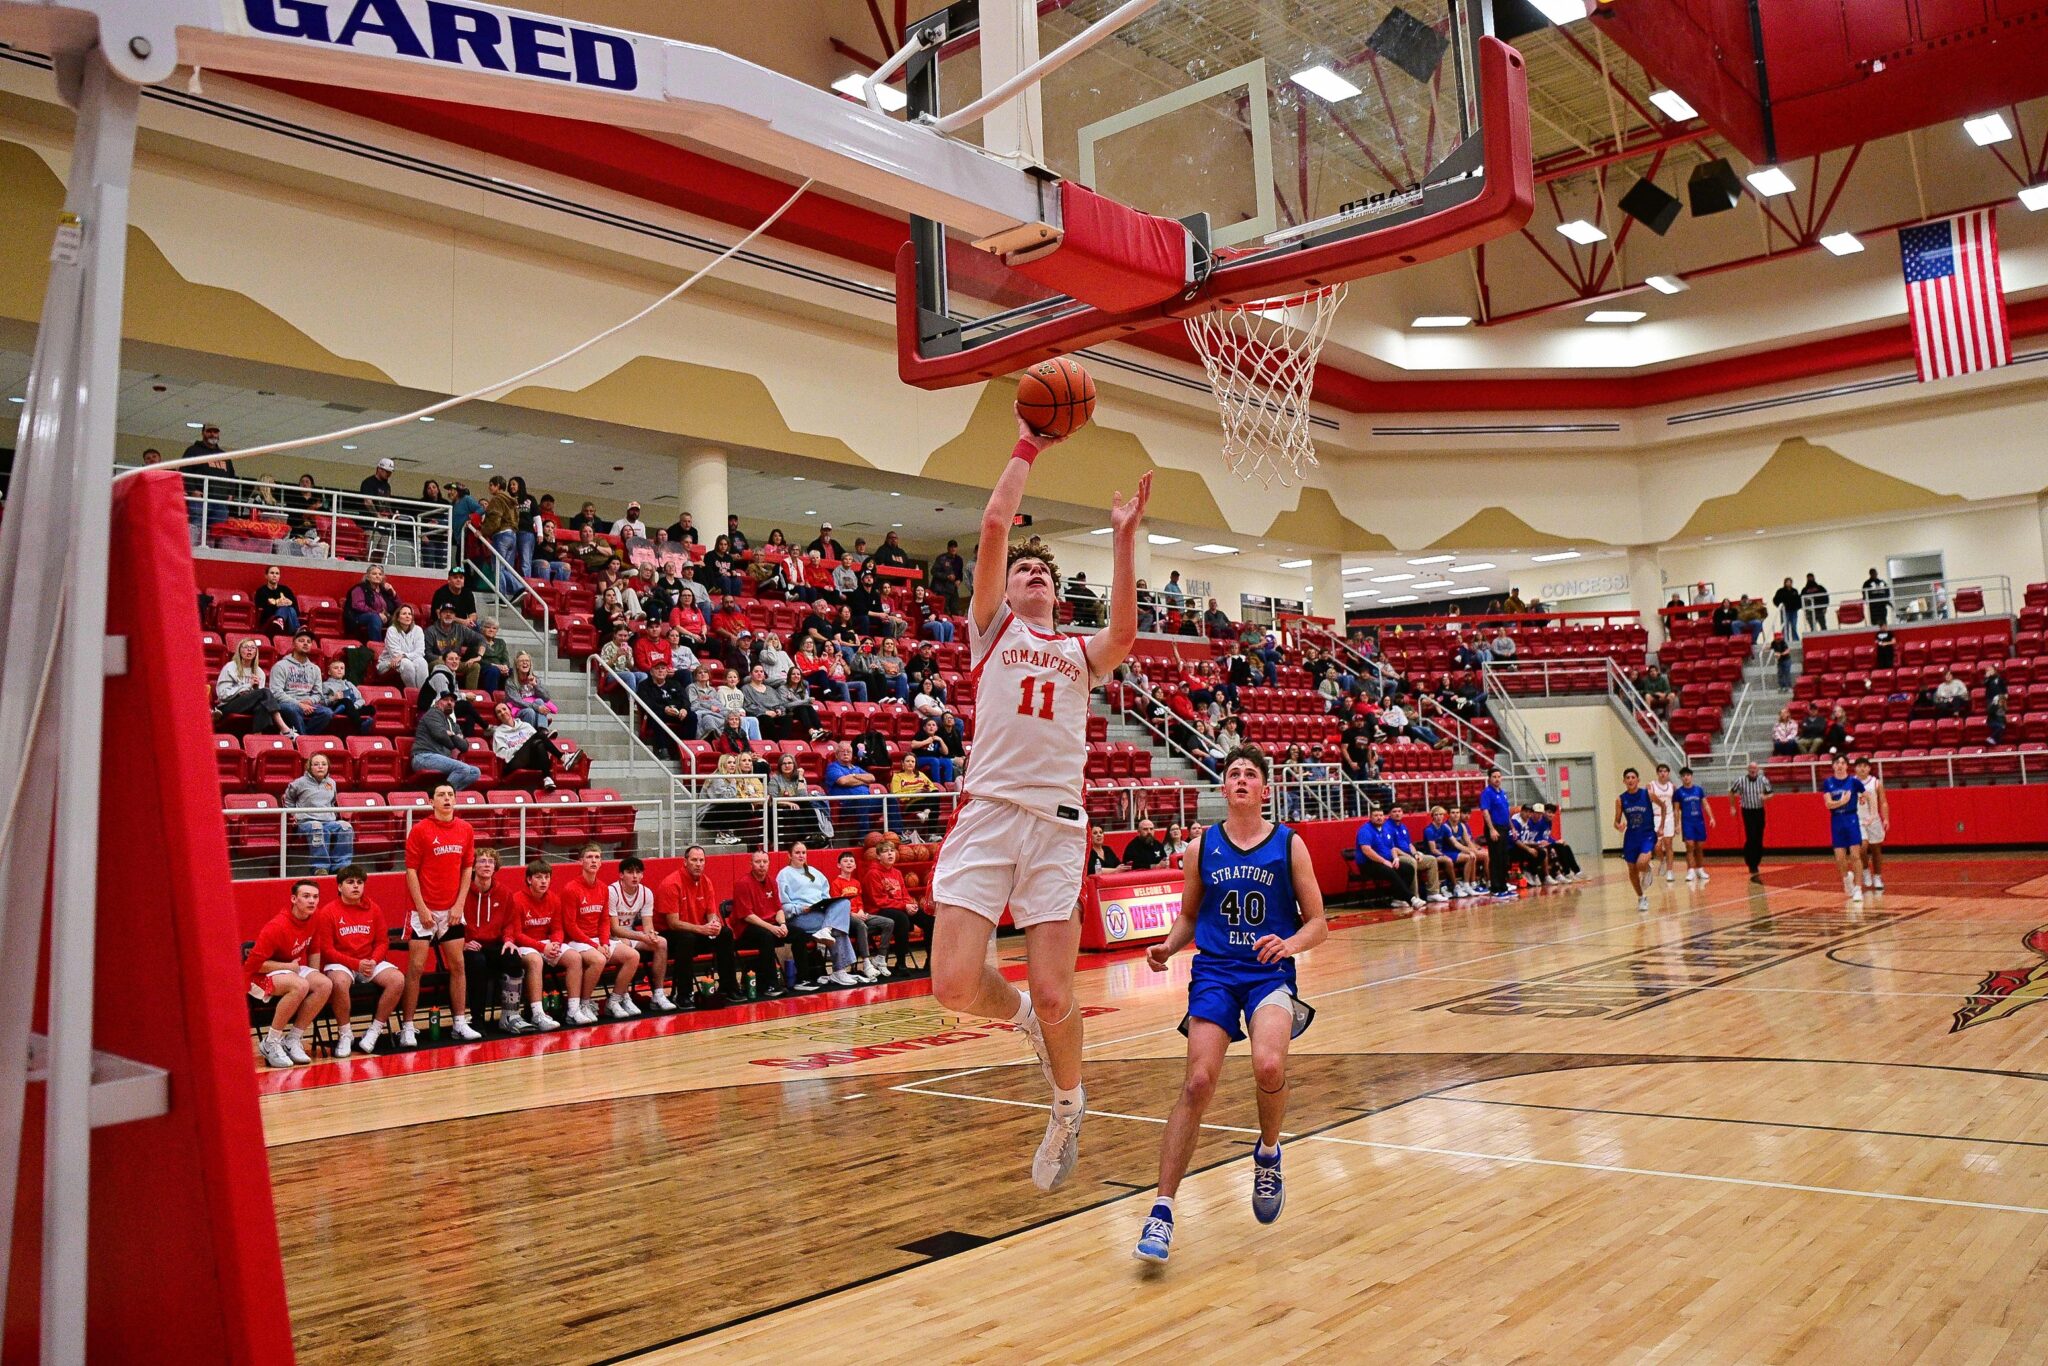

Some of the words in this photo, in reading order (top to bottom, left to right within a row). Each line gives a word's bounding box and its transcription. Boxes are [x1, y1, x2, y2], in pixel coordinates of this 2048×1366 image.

[243, 0, 638, 92] GARED
[1001, 649, 1081, 682] COMANCHES
[1017, 675, 1056, 721] 11
[1133, 886, 1164, 897] WELCOME
[1164, 885, 1172, 894] TO
[1211, 865, 1275, 887] STRATFORD
[1129, 903, 1165, 931] WEST
[1219, 889, 1266, 926] 40
[1228, 931, 1257, 946] ELKS
